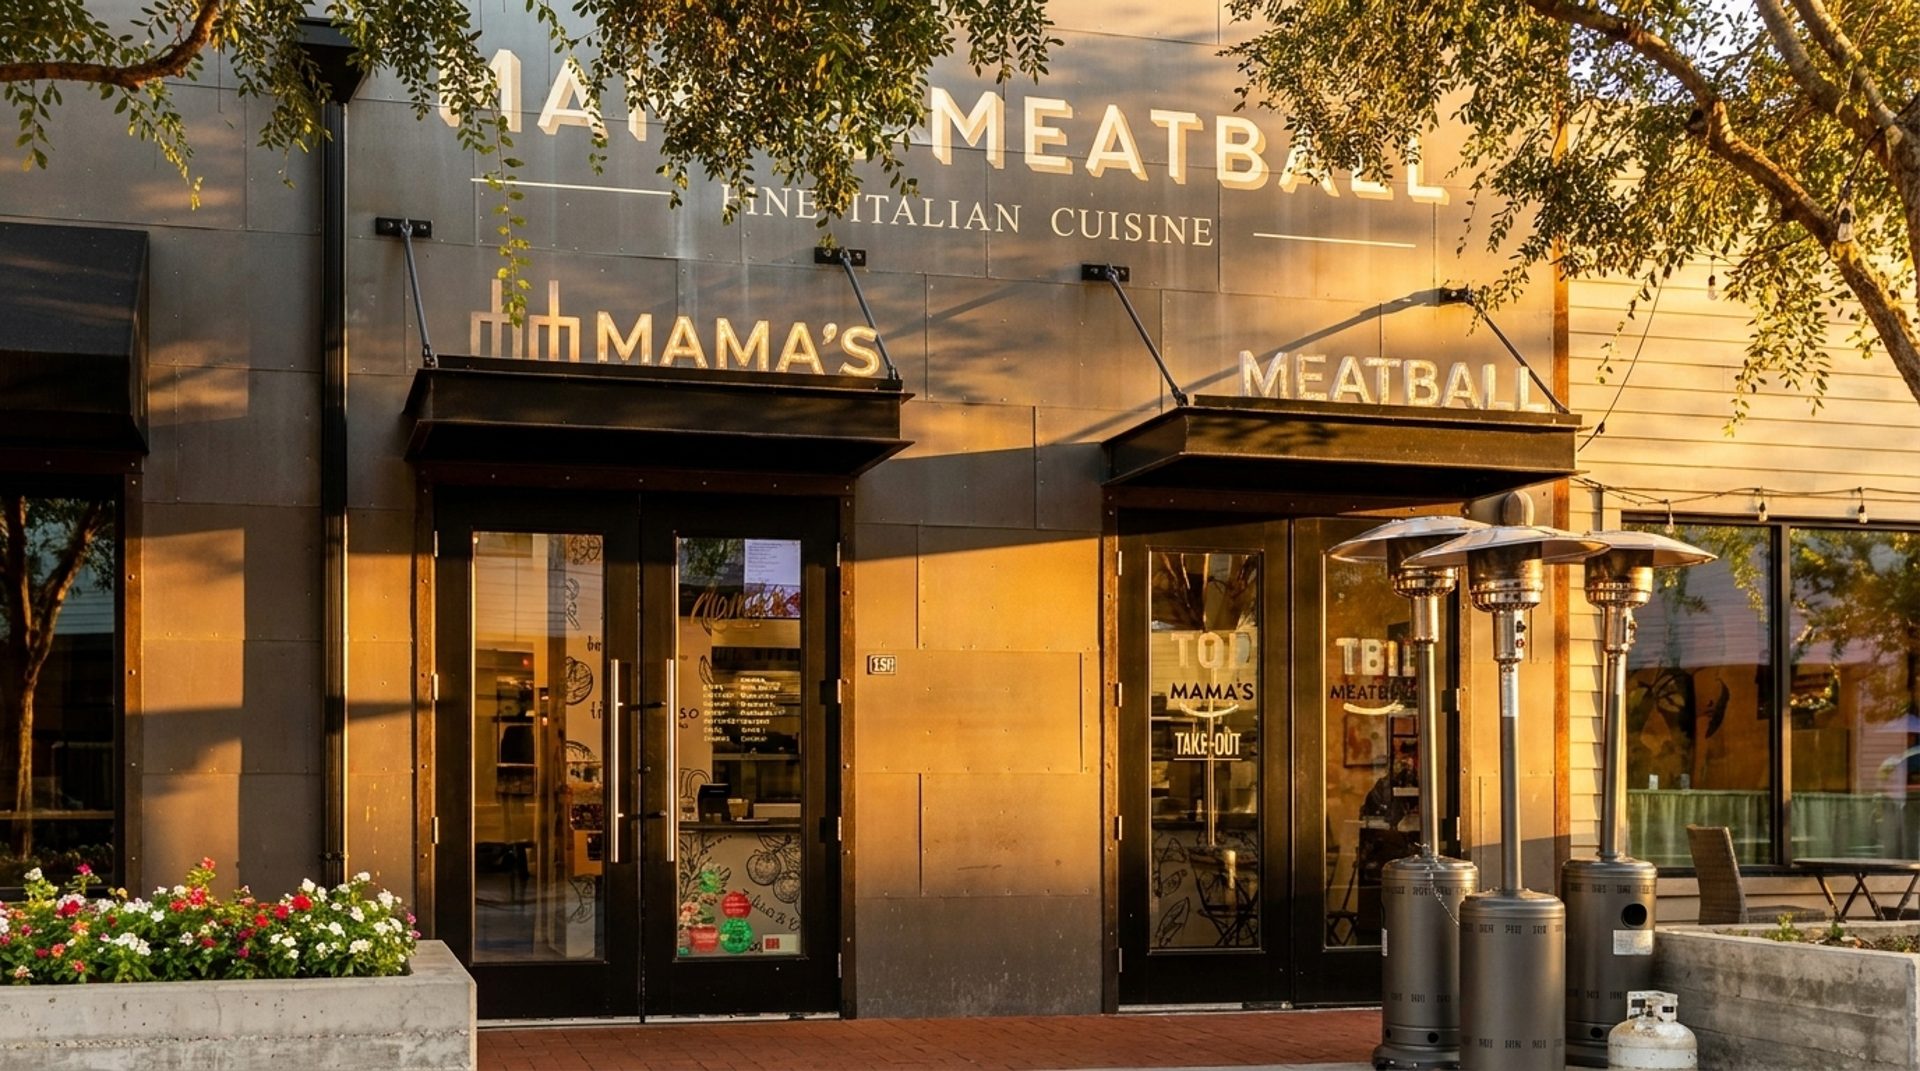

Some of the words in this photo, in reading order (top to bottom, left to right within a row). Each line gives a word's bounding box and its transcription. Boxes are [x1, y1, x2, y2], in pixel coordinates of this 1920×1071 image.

[849, 192, 1021, 234] ITALIAN
[1050, 207, 1214, 247] CUISINE
[596, 310, 880, 378] MAMA'S
[1239, 349, 1553, 412] MEATBALL
[1170, 682, 1255, 701] MAMA'S
[1174, 731, 1242, 756] TAKE-OUT
